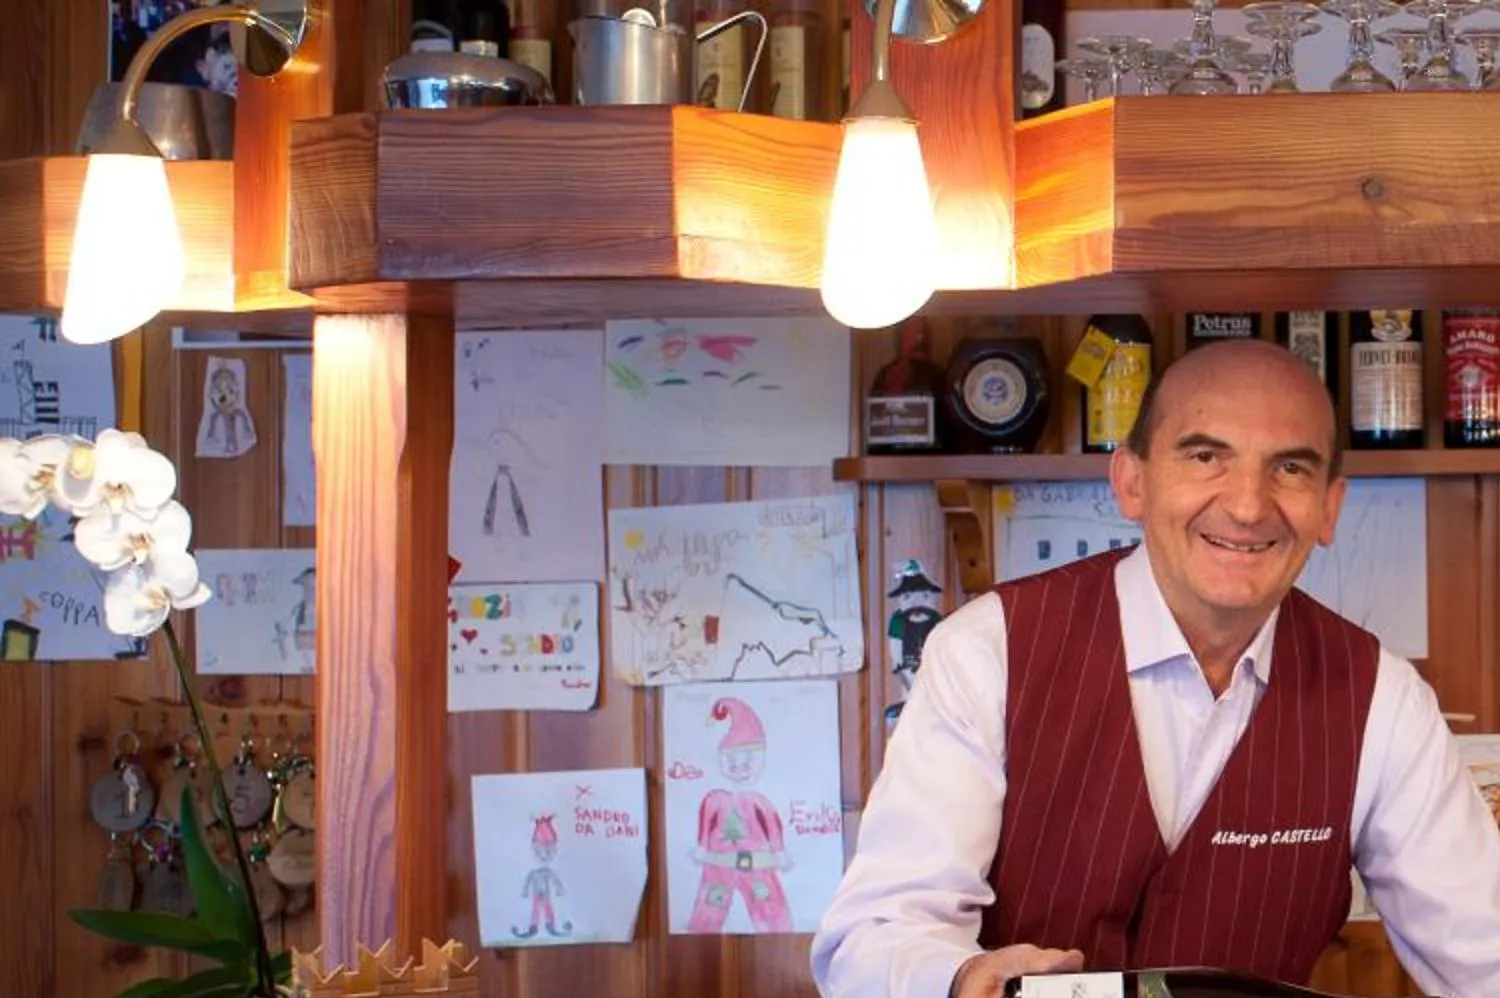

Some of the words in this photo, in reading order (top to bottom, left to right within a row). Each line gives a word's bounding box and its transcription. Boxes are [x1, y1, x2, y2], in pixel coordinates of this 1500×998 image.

[1193, 314, 1252, 330] Petrus
[1450, 329, 1495, 343] AMARO
[1211, 831, 1268, 849] Albergo
[1271, 826, 1333, 844] CASTELLO
